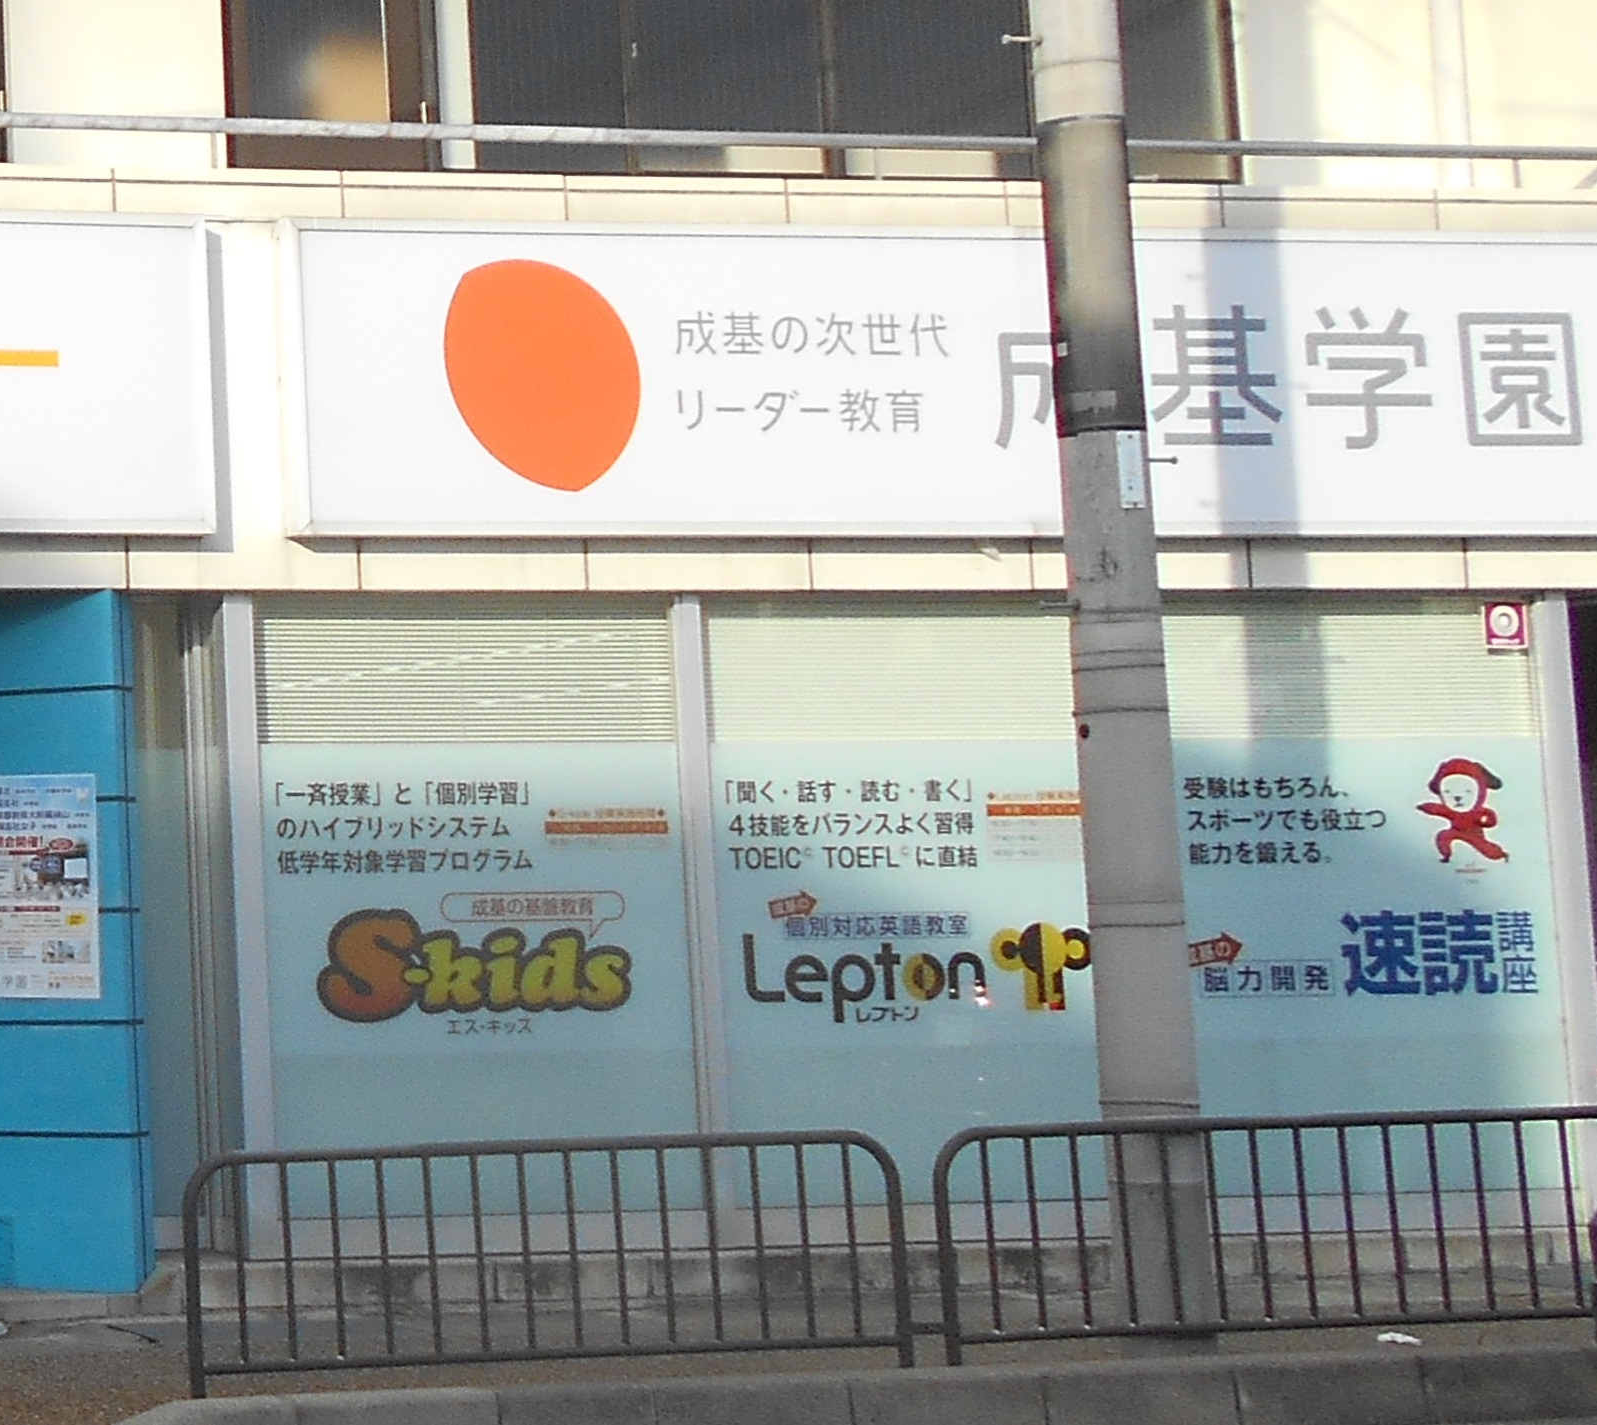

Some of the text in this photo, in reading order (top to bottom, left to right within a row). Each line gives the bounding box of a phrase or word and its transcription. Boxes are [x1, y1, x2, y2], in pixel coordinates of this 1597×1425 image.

[675, 312, 949, 358] 成基の次世代
[676, 388, 923, 433] リーダー教育
[725, 779, 973, 804] 「聞く・話す・読む・書く」
[1183, 776, 1349, 799] 受験はもちろん、
[277, 817, 510, 839] のハイブリッドシステム
[729, 812, 975, 837] 4技能をバランスよく習得
[1187, 808, 1387, 831] スポーツでも役立つ
[277, 850, 534, 874] 低学年対象学習プログラム
[916, 847, 978, 869] に直結
[1189, 841, 1332, 864] 能力を鍛える。
[785, 914, 969, 937] 個別対応英語教室
[1203, 909, 1539, 996] 脳力開発 速読 講座
[317, 907, 632, 1023] S-kids
[742, 933, 988, 1023] Lepton
[448, 1018, 533, 1034] エス・キッズ
[856, 1006, 919, 1023] レプトン
